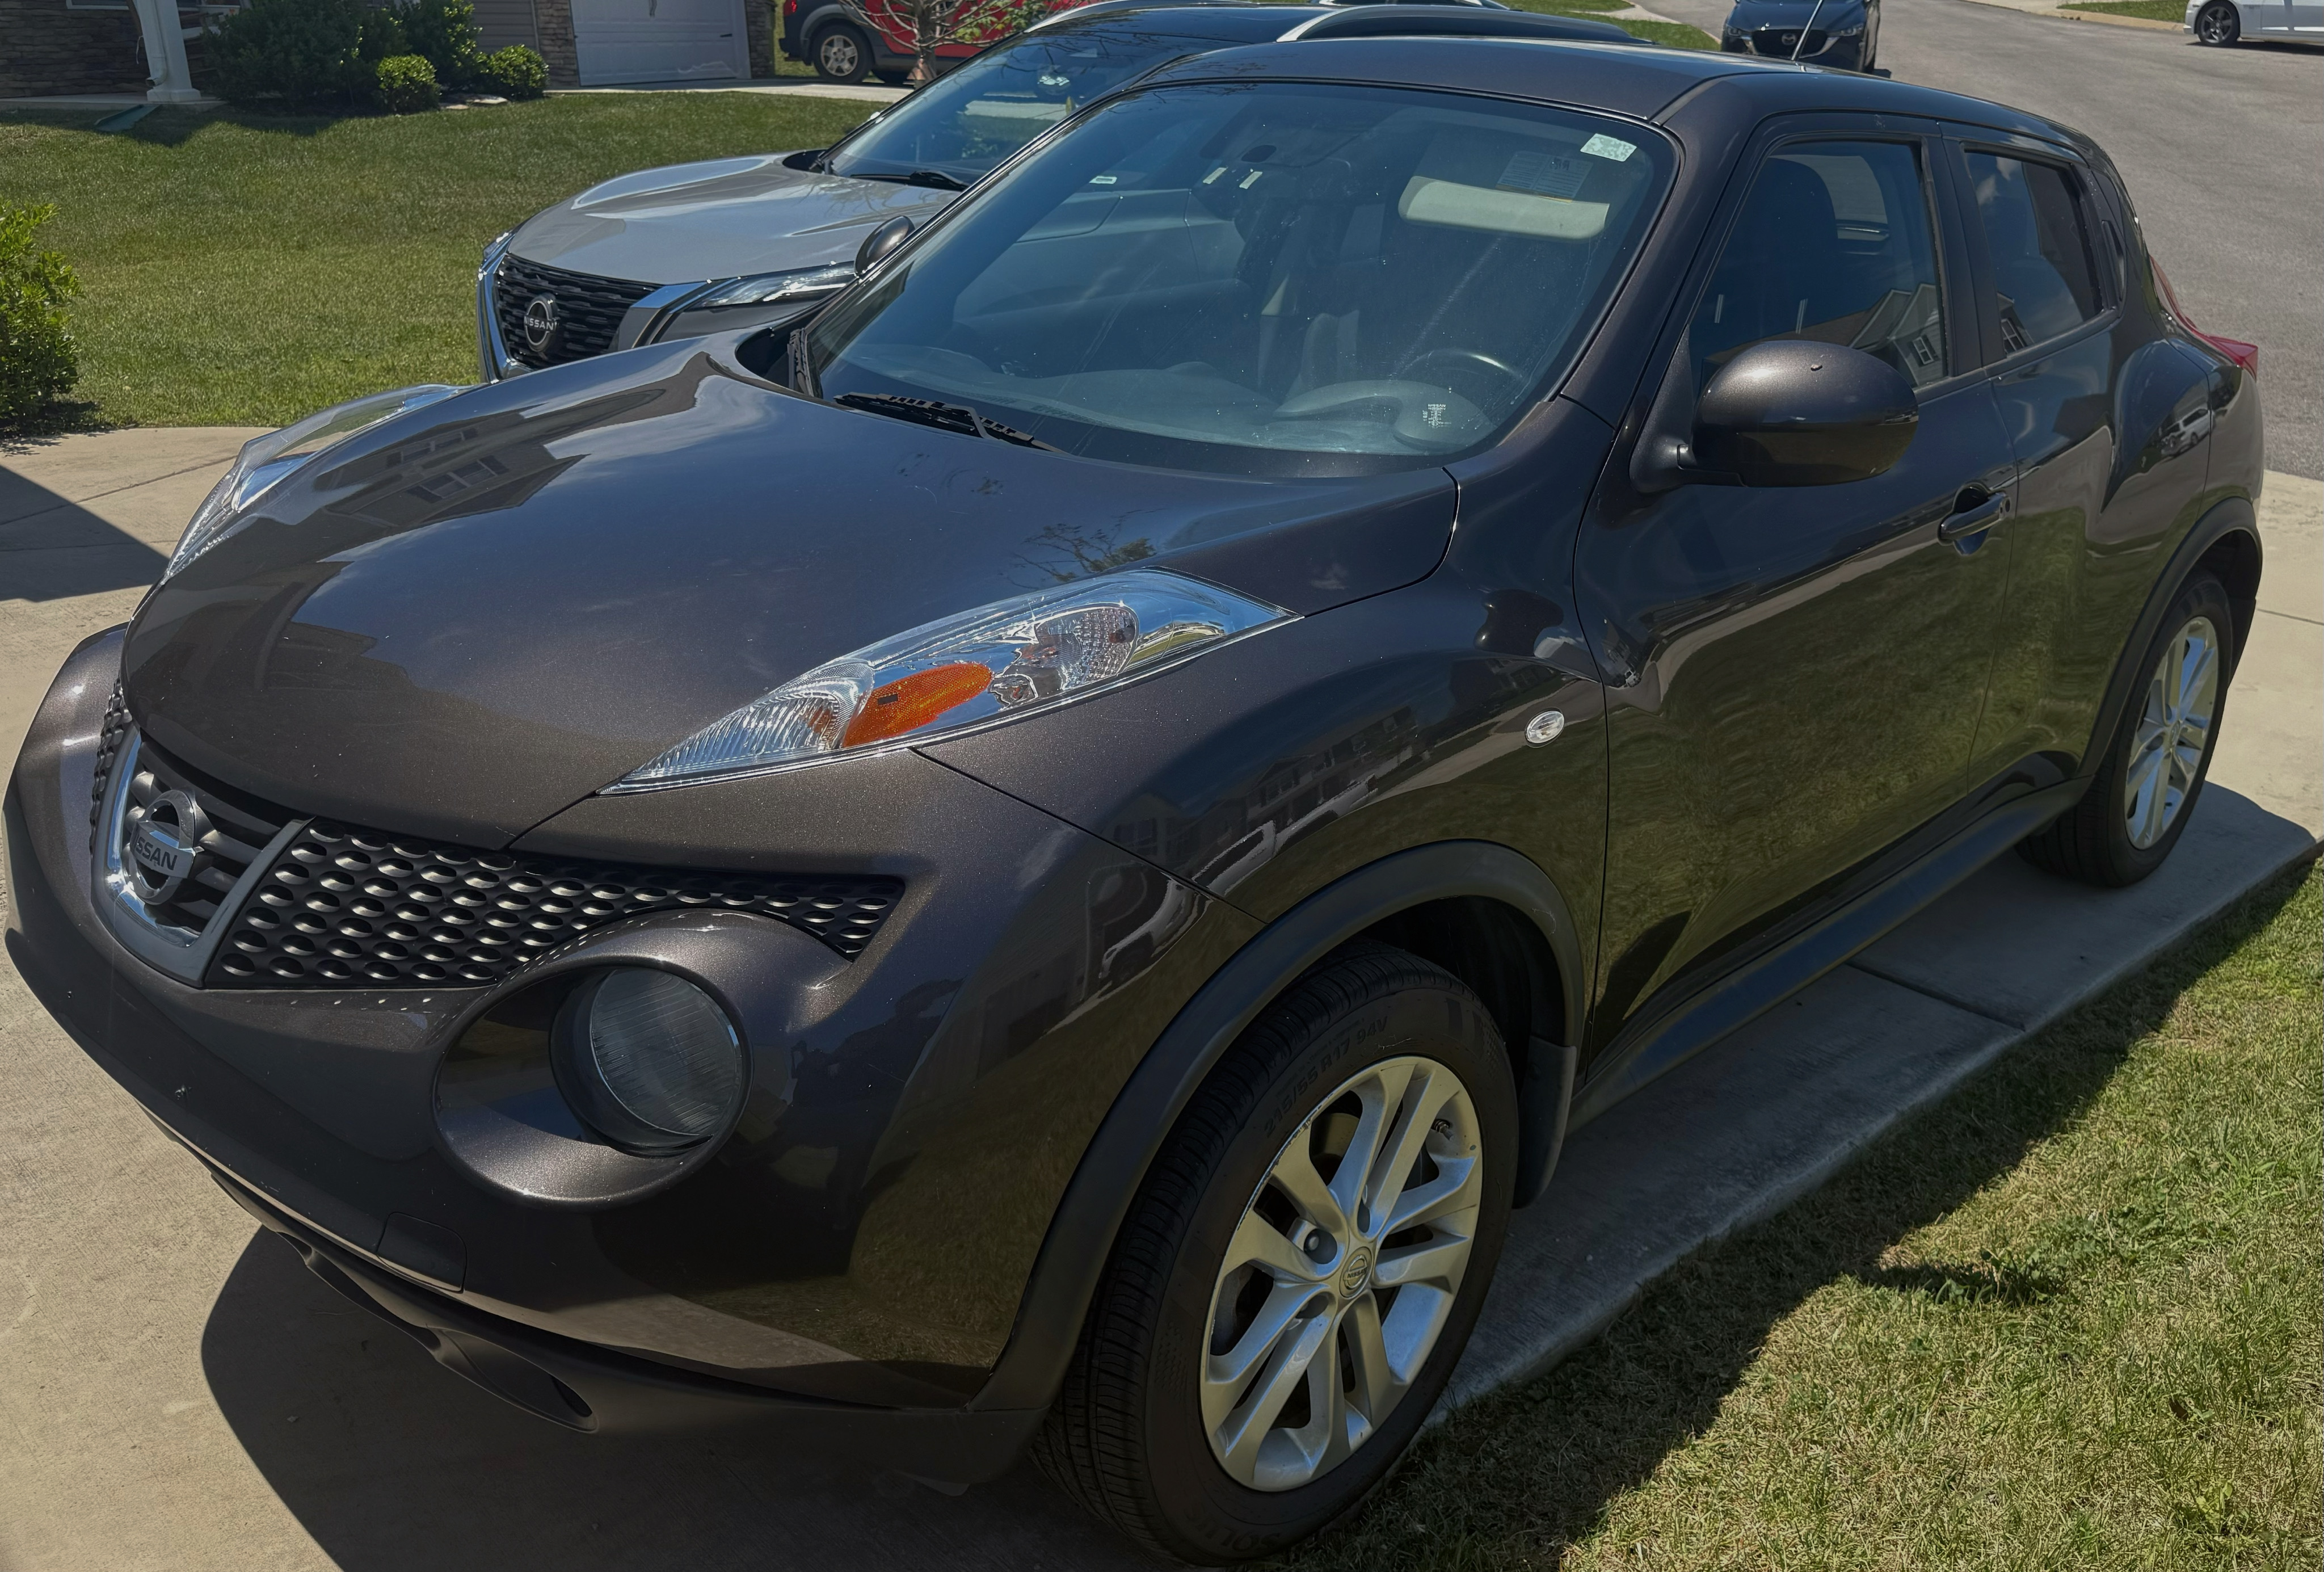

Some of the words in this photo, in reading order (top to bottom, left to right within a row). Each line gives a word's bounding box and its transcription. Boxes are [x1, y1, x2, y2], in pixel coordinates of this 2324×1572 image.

[524, 316, 554, 330] NISSAN
[1264, 1065, 1319, 1138] 215/55
[1320, 1036, 1350, 1071] R17
[1356, 1016, 1388, 1045] 94V
